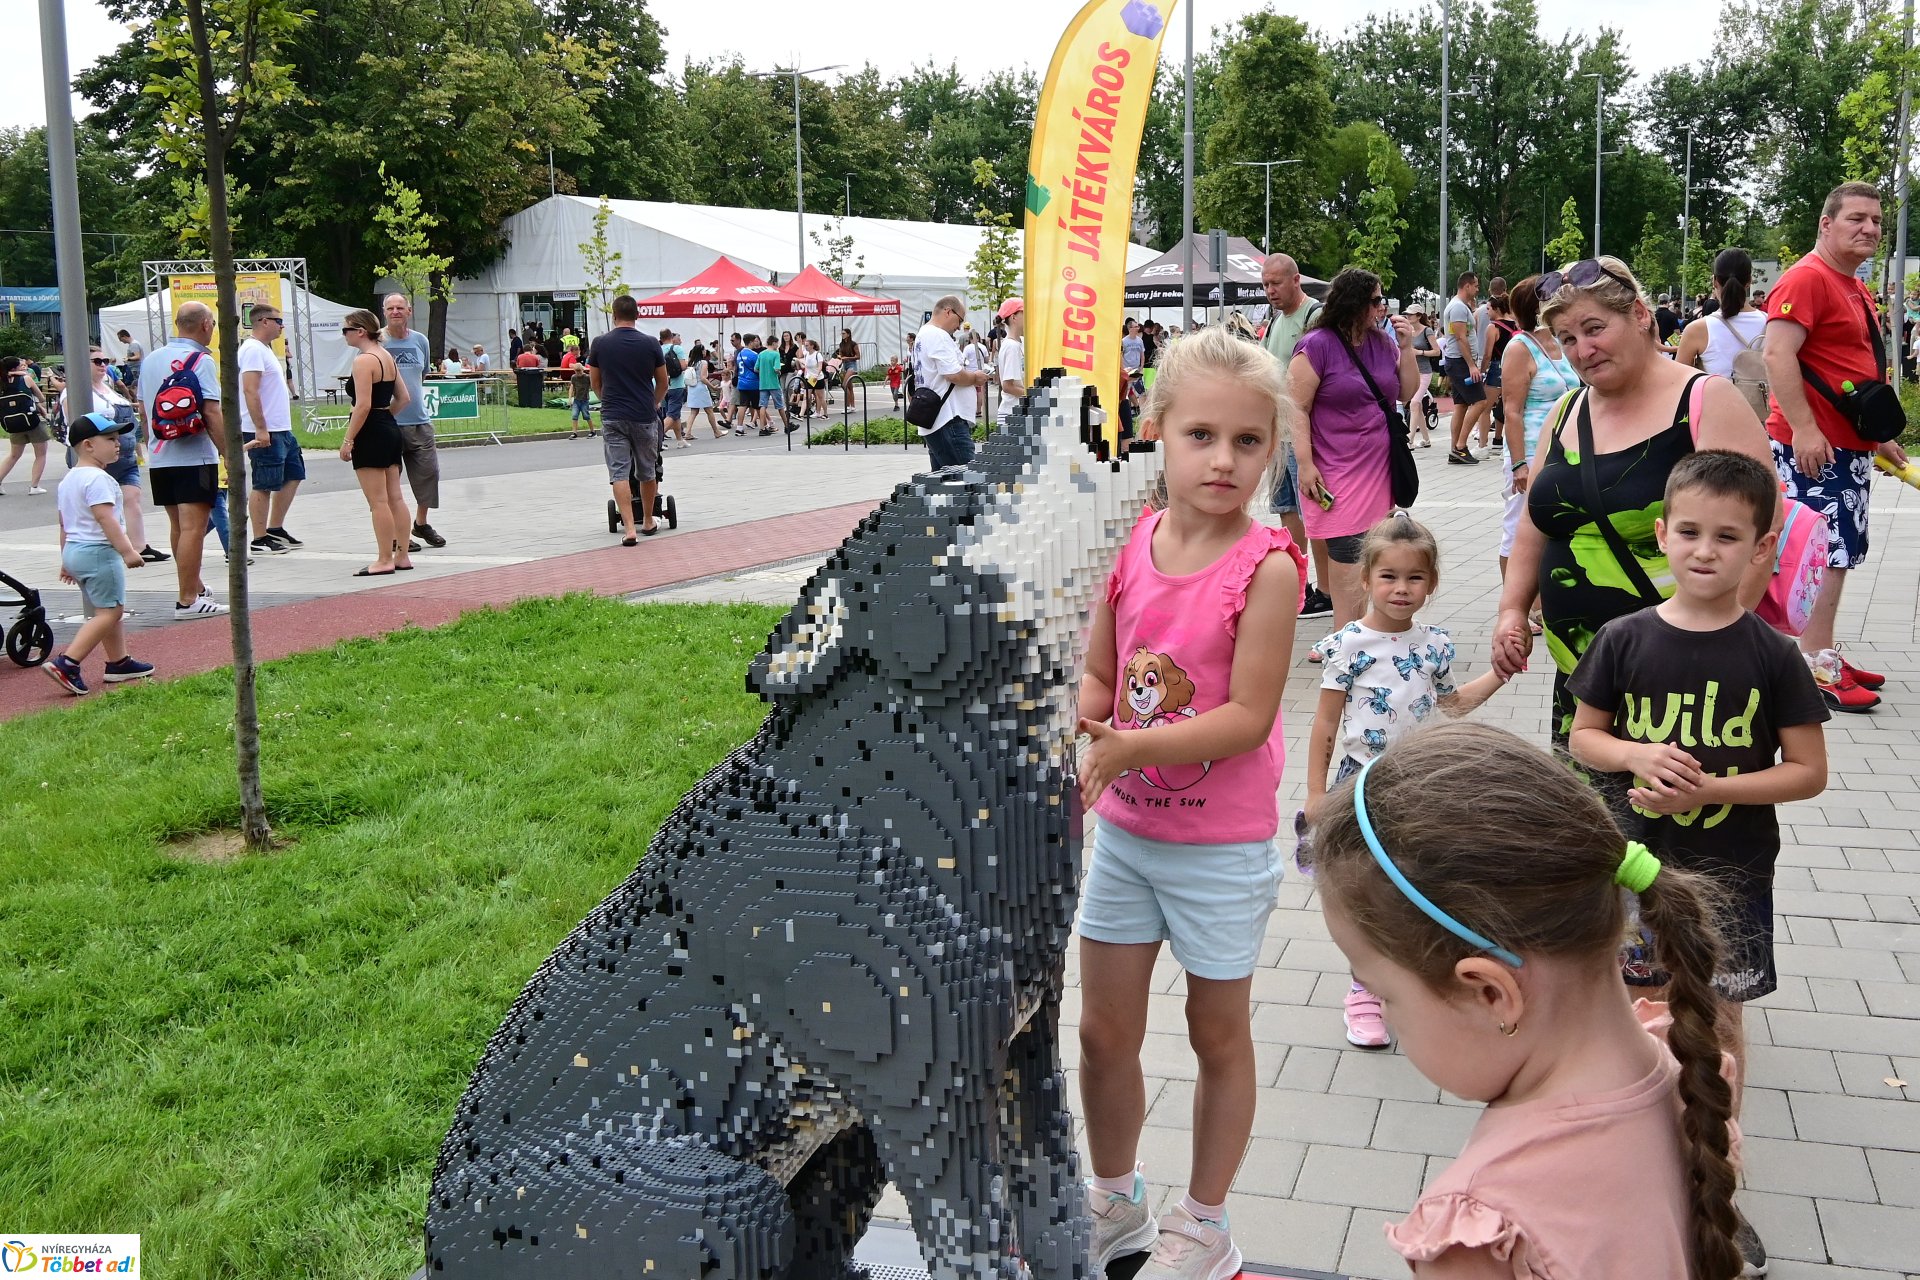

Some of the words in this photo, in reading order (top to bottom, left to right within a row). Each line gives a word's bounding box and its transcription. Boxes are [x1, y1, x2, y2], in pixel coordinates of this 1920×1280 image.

[1058, 41, 1131, 262] JÁTÉKVÁROS
[668, 286, 720, 296] MOTUL
[735, 285, 780, 295] MOTUL
[1124, 291, 1150, 300] lmény
[1150, 290, 1161, 300] jár
[693, 303, 728, 314] MOTUL
[737, 303, 767, 313] MOTUL
[790, 303, 818, 313] MOTUL
[827, 304, 853, 314] MOTUL
[873, 304, 898, 314] MOTUL
[738, 361, 745, 374] 5
[440, 394, 475, 404] VÉSZKIJÁRAT
[1111, 782, 1138, 806] UNDER
[1145, 797, 1171, 808] THE
[1180, 797, 1207, 808] SUN
[1709, 968, 1755, 987] SONIC
[1729, 969, 1765, 996] PRIME
